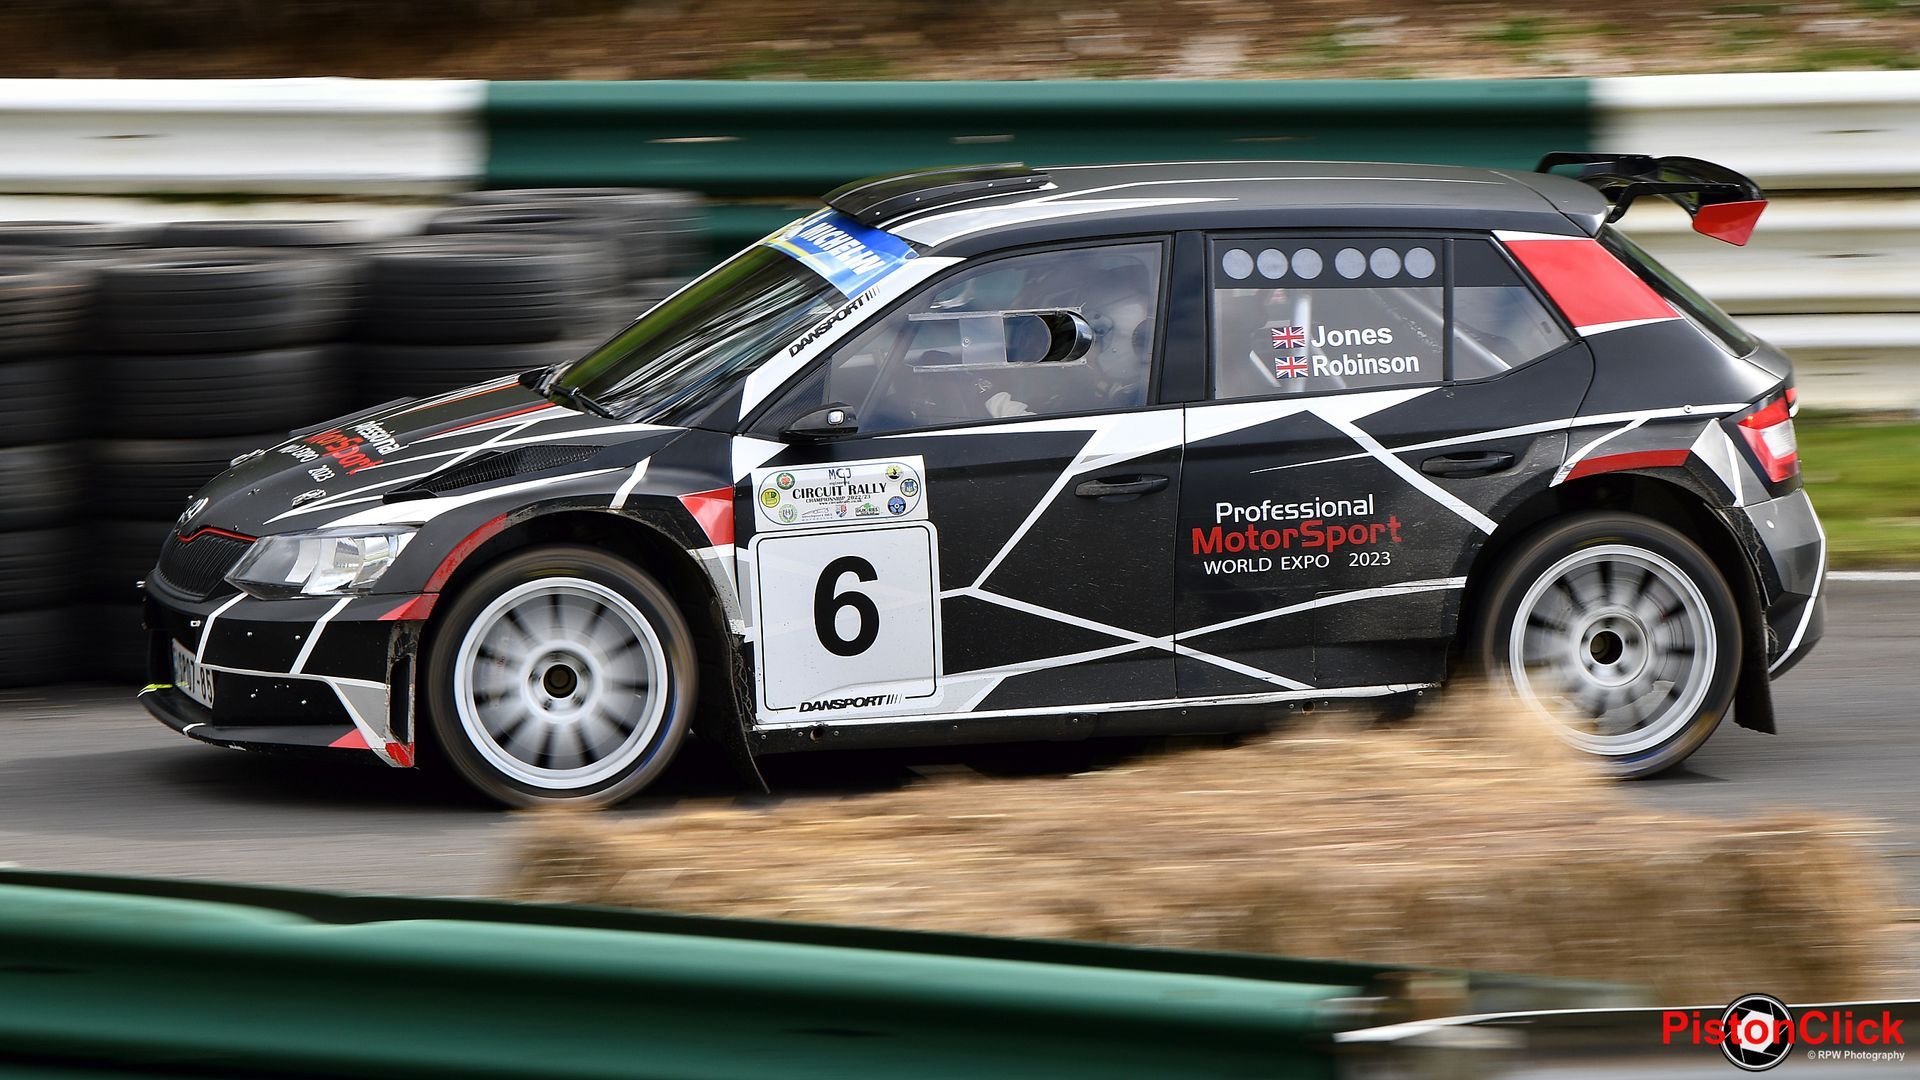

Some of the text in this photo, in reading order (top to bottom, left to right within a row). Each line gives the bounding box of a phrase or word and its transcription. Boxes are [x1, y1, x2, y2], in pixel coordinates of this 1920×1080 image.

[800, 221, 886, 276] MICHELIN
[788, 296, 866, 357] DANSPORT
[1311, 325, 1393, 348] Jones
[1311, 353, 1420, 377] Robinson
[792, 485, 844, 499] CIRCUIT
[848, 482, 887, 496] RALLY
[1216, 493, 1374, 524] Professional
[1191, 515, 1403, 555] MotorSport
[1203, 551, 1391, 575] WORLD EXPO 2023
[813, 555, 880, 658] 6
[799, 695, 887, 712] DANSPORT
